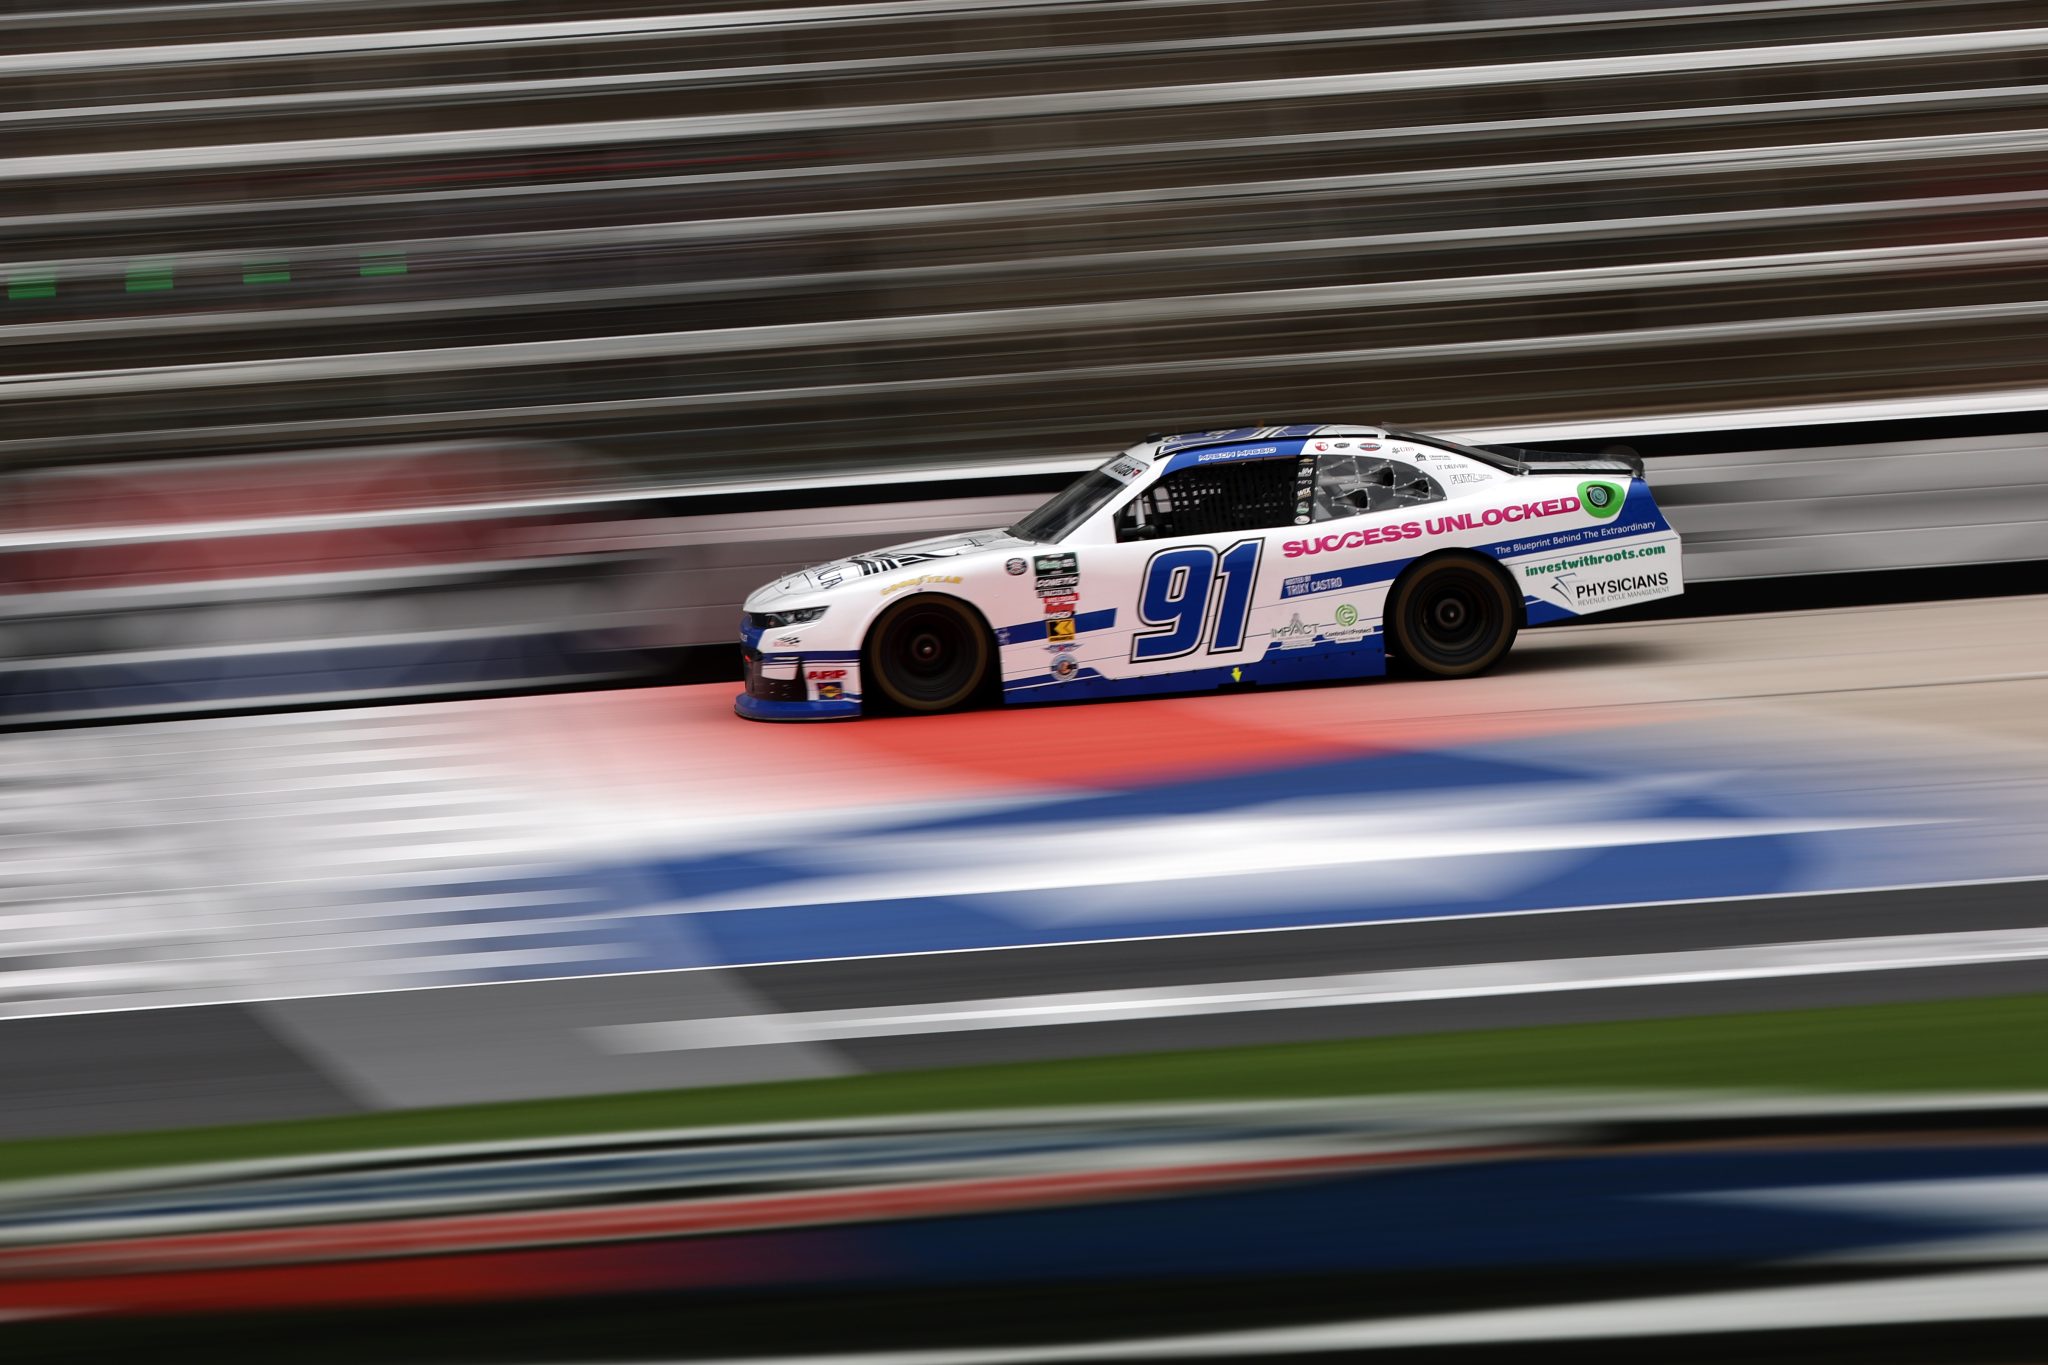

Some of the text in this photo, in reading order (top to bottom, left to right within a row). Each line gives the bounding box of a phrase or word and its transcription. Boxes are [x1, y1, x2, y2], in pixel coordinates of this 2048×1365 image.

[1282, 496, 1581, 558] SUCCESS UNLOCKED
[1495, 520, 1656, 555] The Blueprint Behind The Extraordinary
[1525, 545, 1666, 577] investwithroots.com
[1311, 576, 1343, 592] CASTRO
[1576, 572, 1669, 599] PHYSICIANS
[1577, 587, 1670, 606] REVENUE CYCLE MANAGEMENT
[1130, 537, 1266, 664] 91
[1270, 618, 1319, 638] IMPACT
